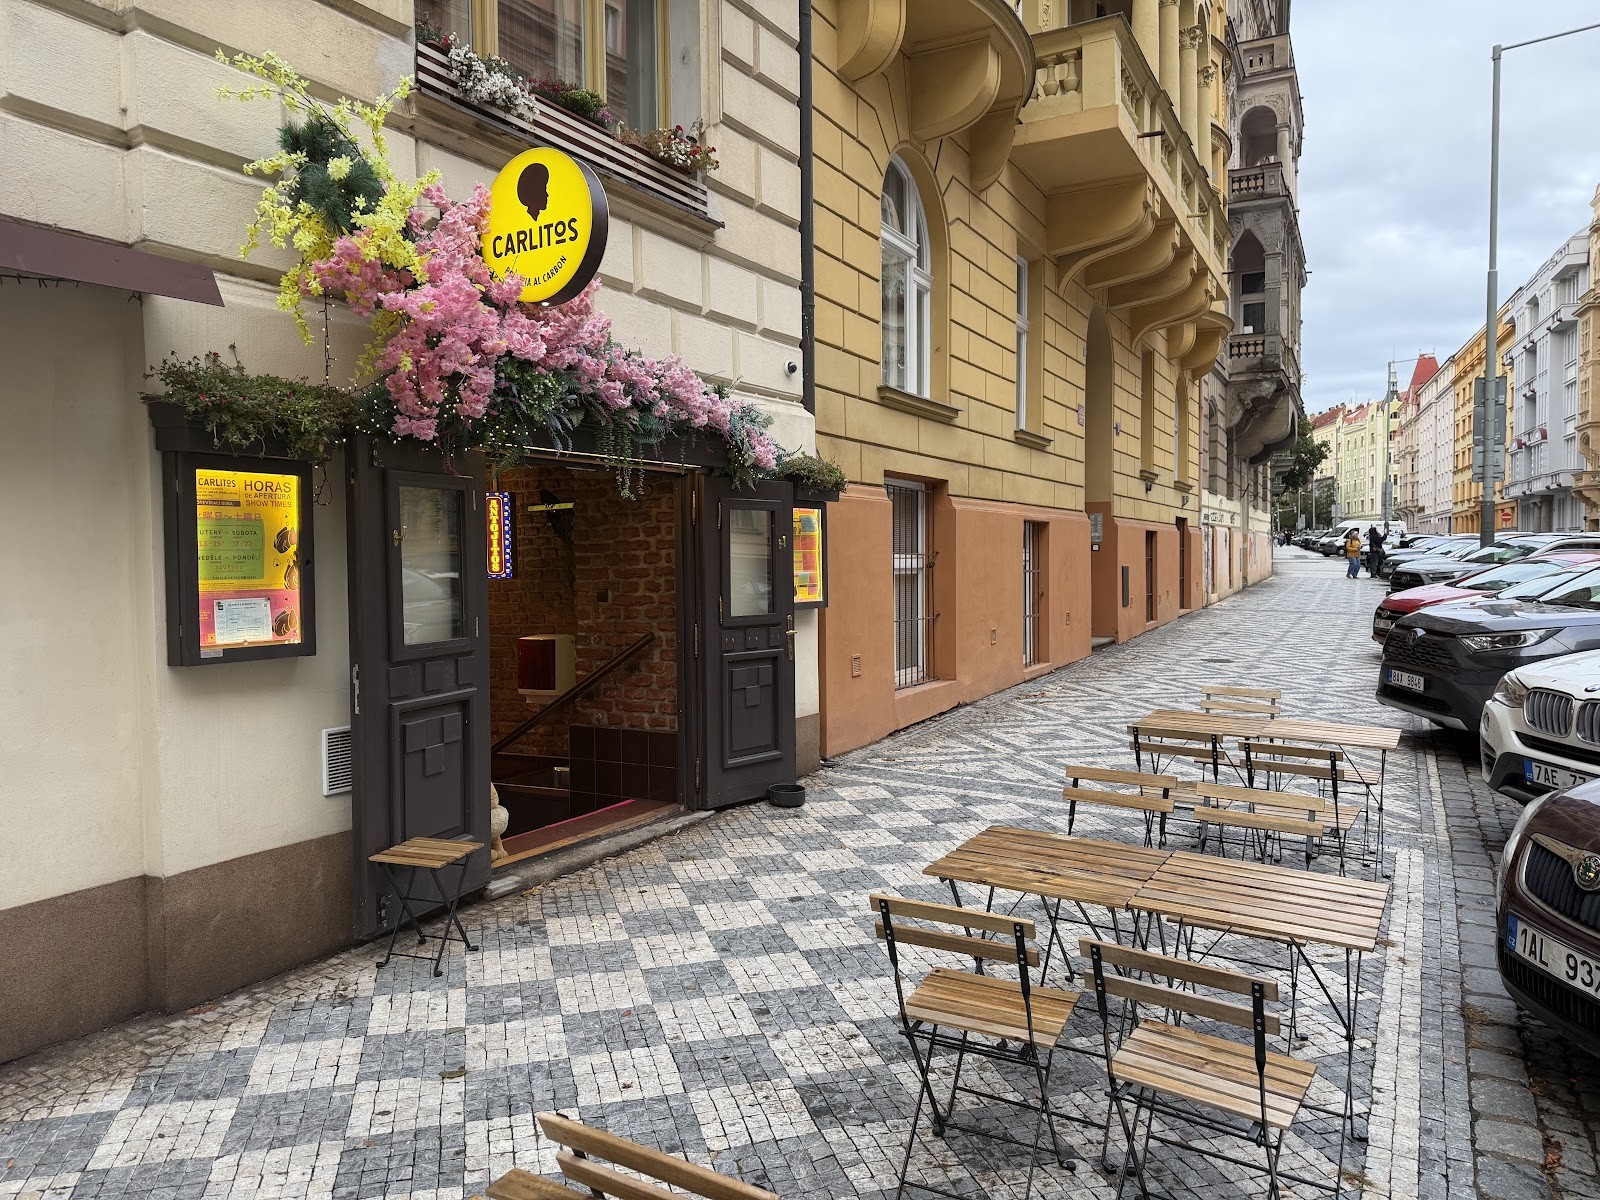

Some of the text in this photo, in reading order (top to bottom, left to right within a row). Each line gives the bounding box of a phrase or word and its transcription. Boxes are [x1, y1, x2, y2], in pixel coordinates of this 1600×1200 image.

[492, 217, 579, 258] CARLITOS
[533, 276, 542, 286] AL
[542, 255, 567, 283] CARBON
[198, 477, 237, 488] CARLITOS
[244, 480, 292, 493] HORAS
[246, 499, 292, 508] SHOW TIMES
[489, 499, 500, 572] ANTOJITOS
[1535, 765, 1559, 786] 7AE
[1569, 774, 1587, 785] 77
[1508, 935, 1516, 947] CZ
[1520, 928, 1549, 967] 1AL
